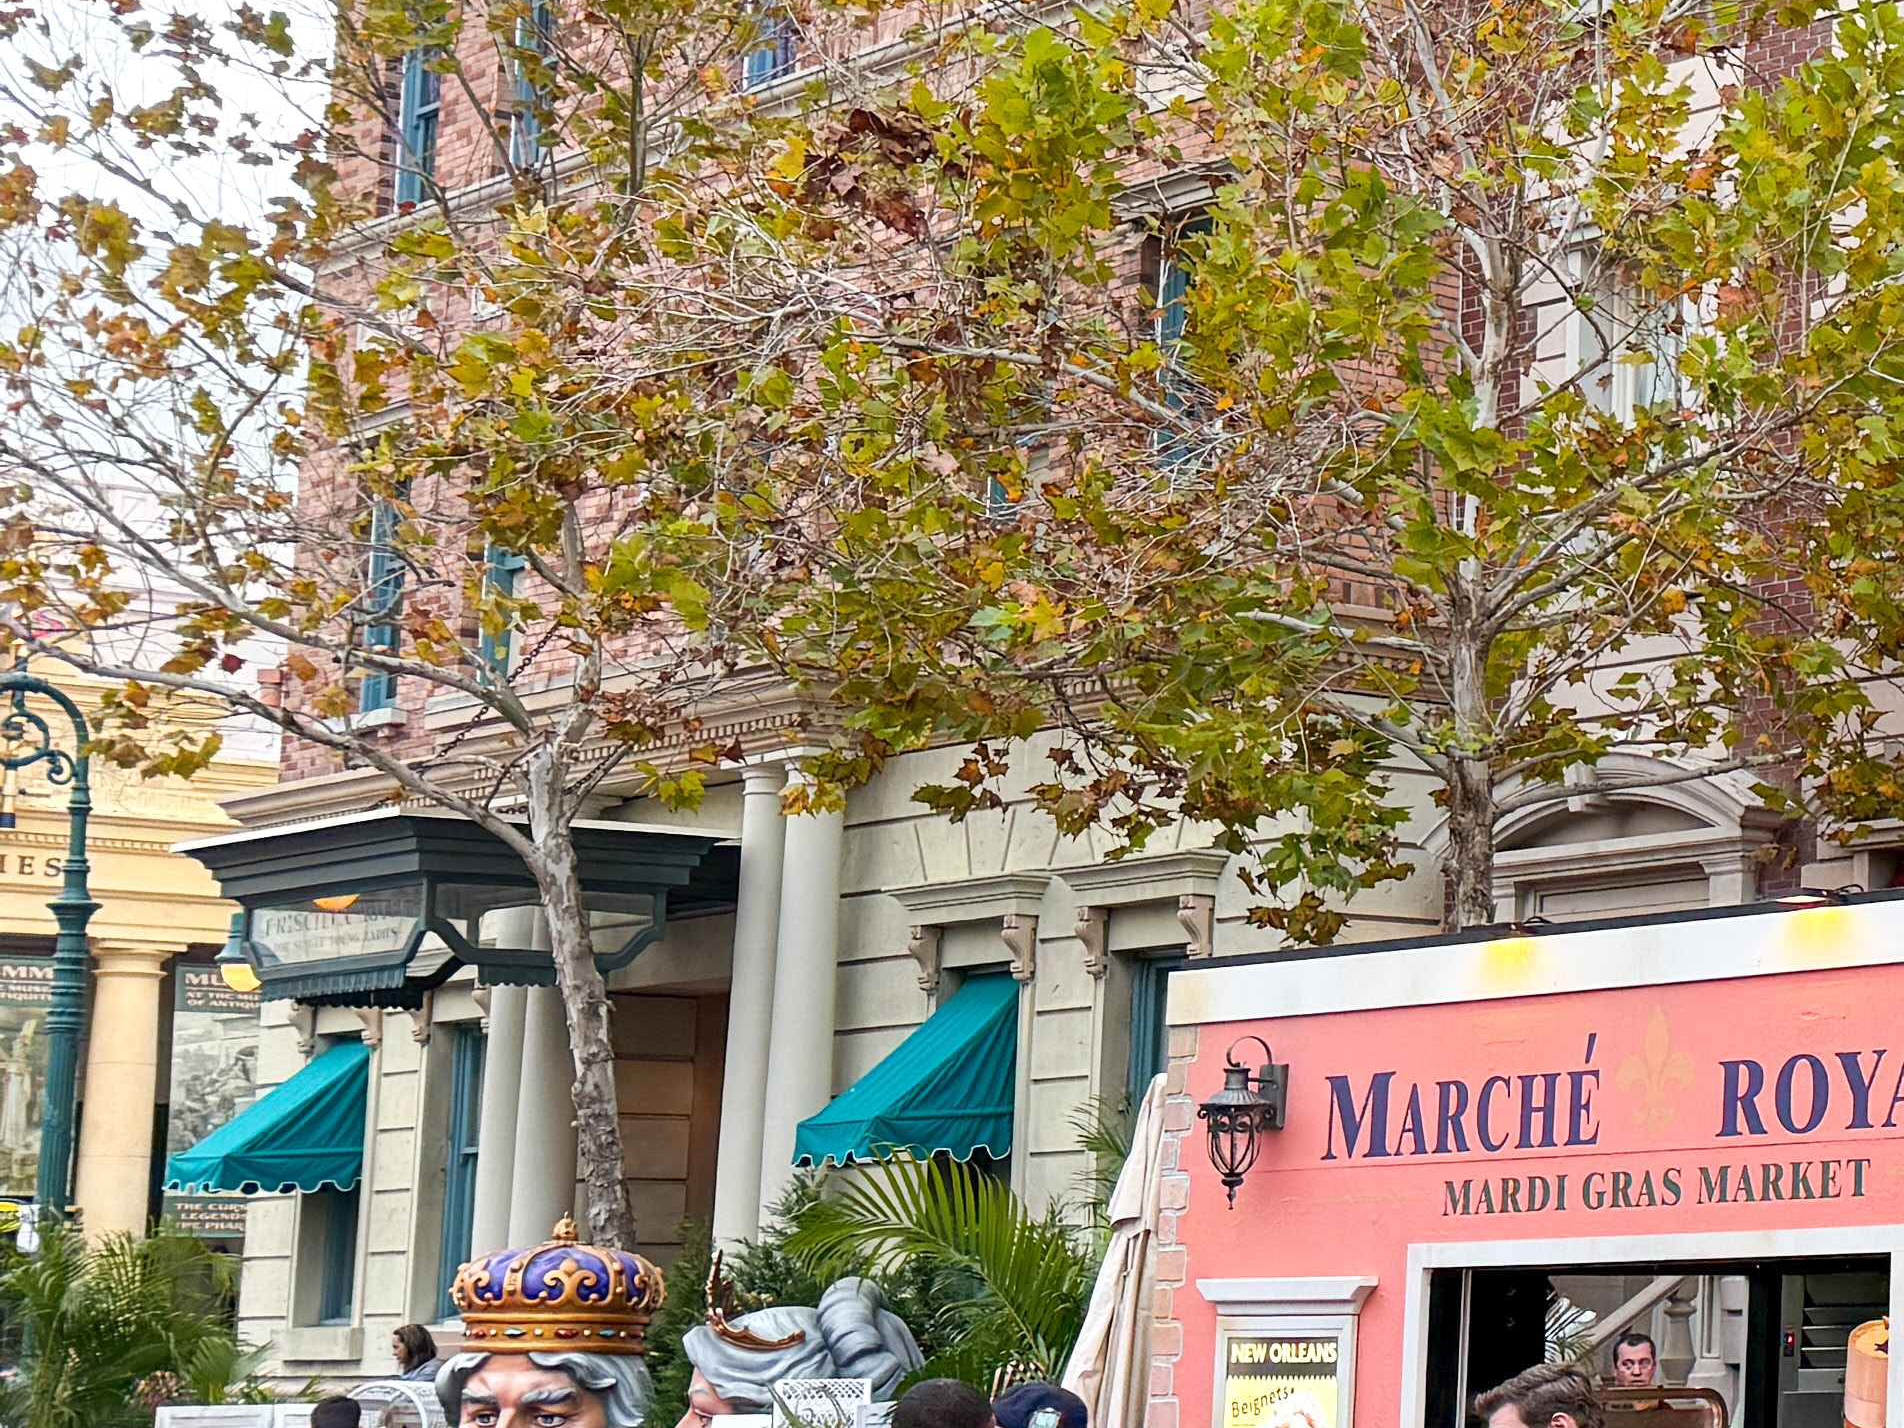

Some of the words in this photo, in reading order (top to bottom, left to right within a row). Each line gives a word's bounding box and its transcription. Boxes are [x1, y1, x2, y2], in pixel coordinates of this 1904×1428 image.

[1321, 1032, 1599, 1160] MARCHÉ
[1441, 1173, 1569, 1217] MARDI
[1582, 1166, 1684, 1212] GRAS
[1695, 1158, 1871, 1205] MARKET
[1230, 1343, 1267, 1364] NEW
[1269, 1341, 1338, 1364] ORLEANS
[1231, 1386, 1289, 1419] Beignets
